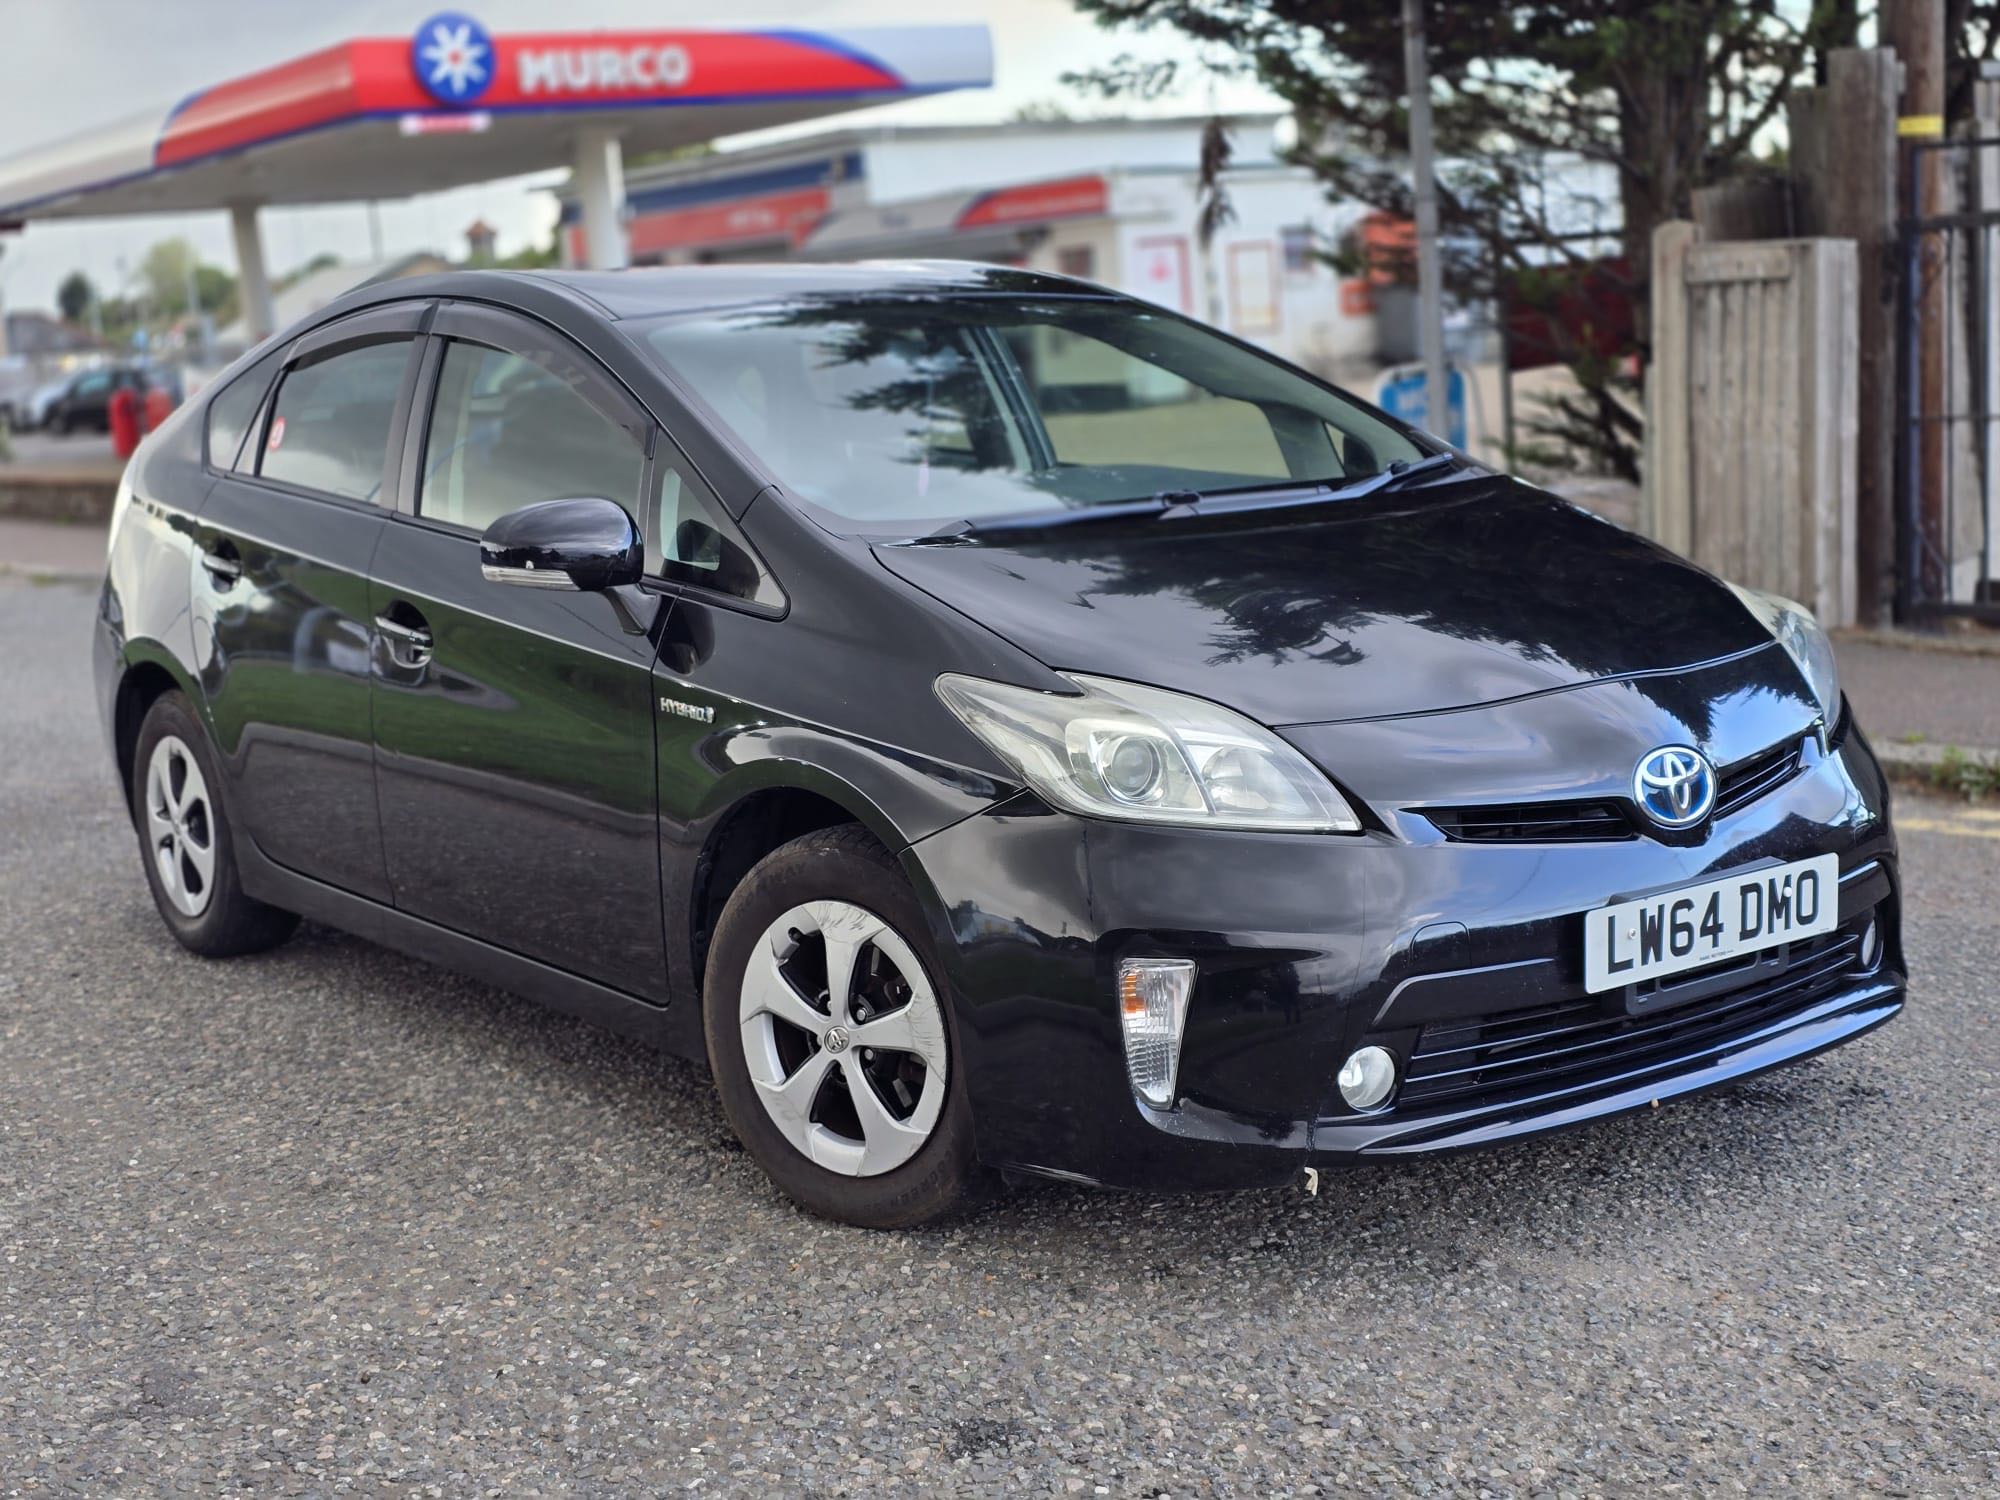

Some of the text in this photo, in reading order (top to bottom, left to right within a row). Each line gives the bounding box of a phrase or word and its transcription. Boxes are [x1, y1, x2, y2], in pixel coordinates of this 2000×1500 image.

[517, 46, 690, 93] MURCO
[660, 697, 704, 721] HYBRID
[1607, 869, 1819, 974] LW64 DMO
